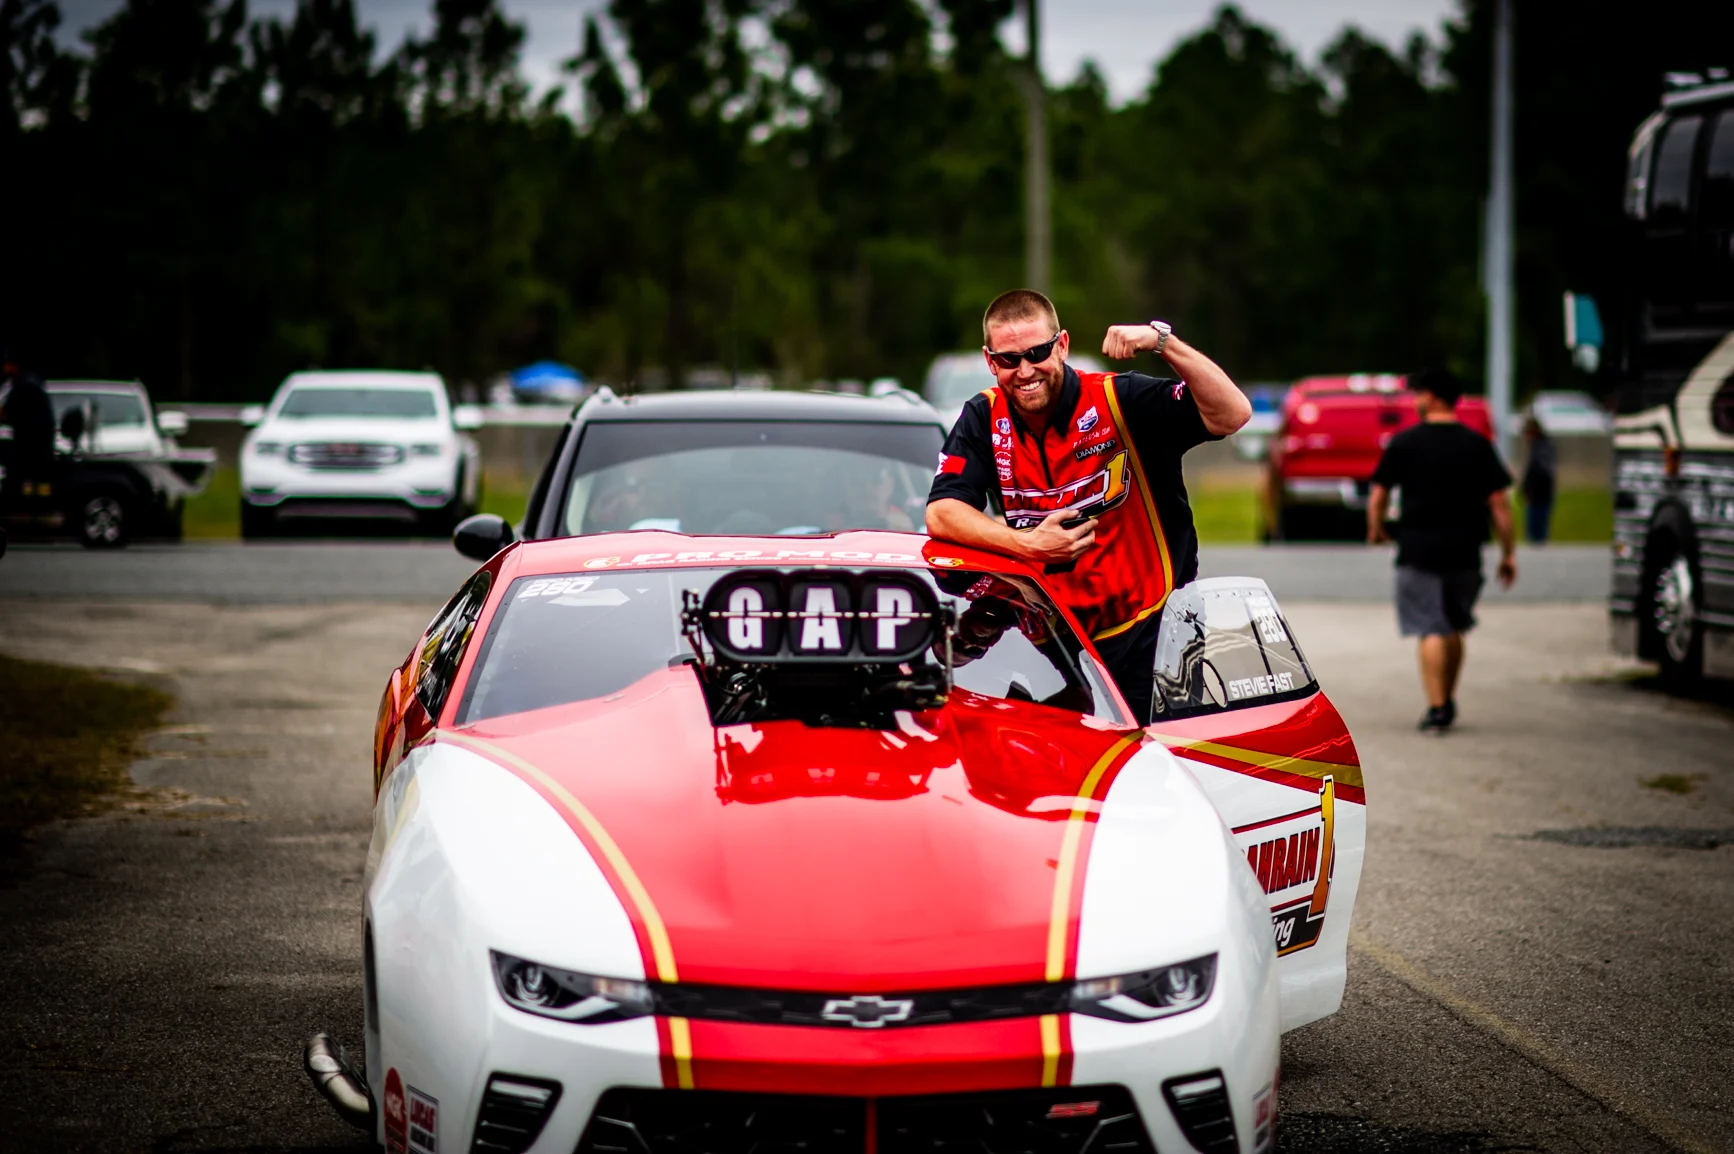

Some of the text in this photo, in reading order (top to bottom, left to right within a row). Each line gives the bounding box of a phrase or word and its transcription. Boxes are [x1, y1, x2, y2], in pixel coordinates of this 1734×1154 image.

[1076, 440, 1115, 459] DIAMOND
[1105, 452, 1126, 502] 1
[631, 550, 763, 564] PRO
[776, 550, 917, 561] MOD
[517, 580, 594, 598] 280
[1254, 607, 1288, 643] 280
[1229, 672, 1295, 699] STEVIE FAST
[1246, 826, 1321, 896] AHRAIN
